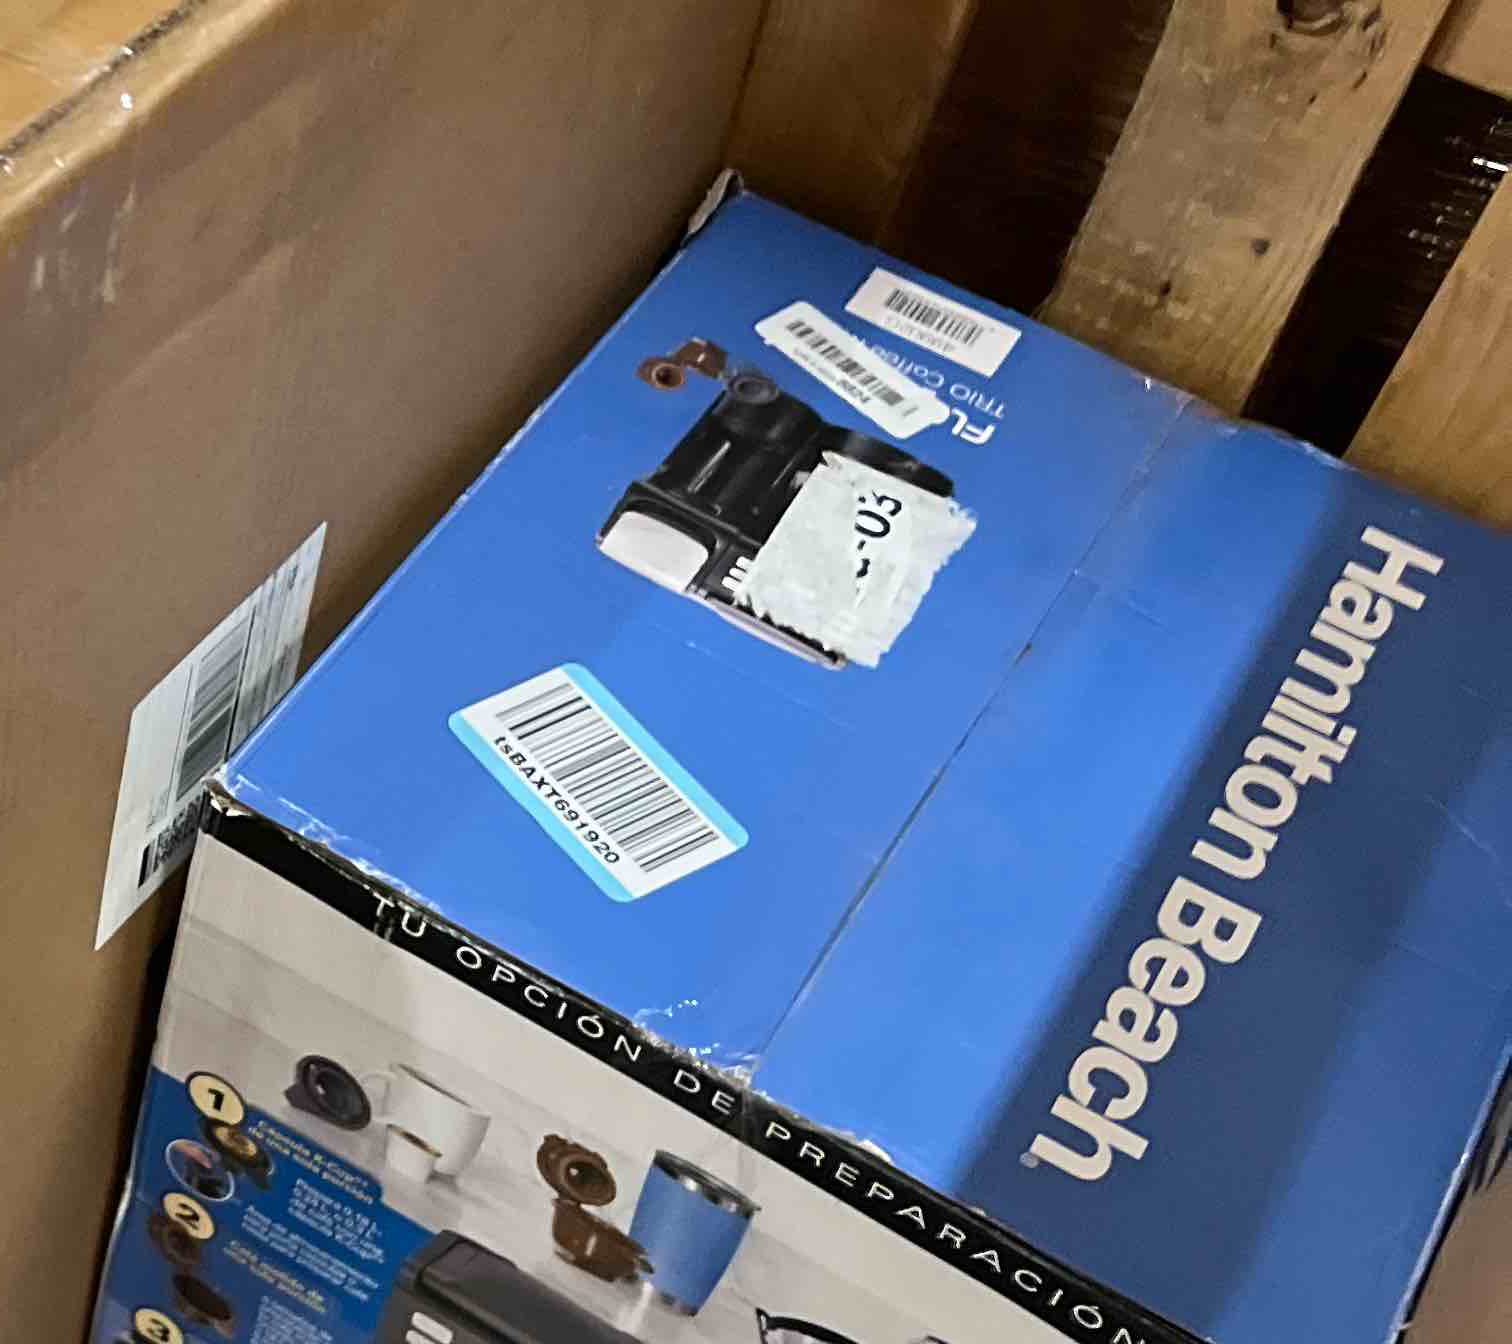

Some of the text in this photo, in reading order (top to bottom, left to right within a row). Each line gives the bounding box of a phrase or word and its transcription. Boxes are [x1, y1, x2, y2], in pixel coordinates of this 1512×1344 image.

[948, 382, 1006, 420] TRIO
[950, 407, 996, 445] FL
[493, 734, 622, 866] tsBAXT691920
[1029, 525, 1445, 1182] Hamilton Beach
[370, 896, 430, 940] TU
[455, 944, 647, 1065] OPCIÓN
[674, 1068, 737, 1117] DE
[206, 1087, 226, 1113] 1
[176, 1202, 202, 1230] 2
